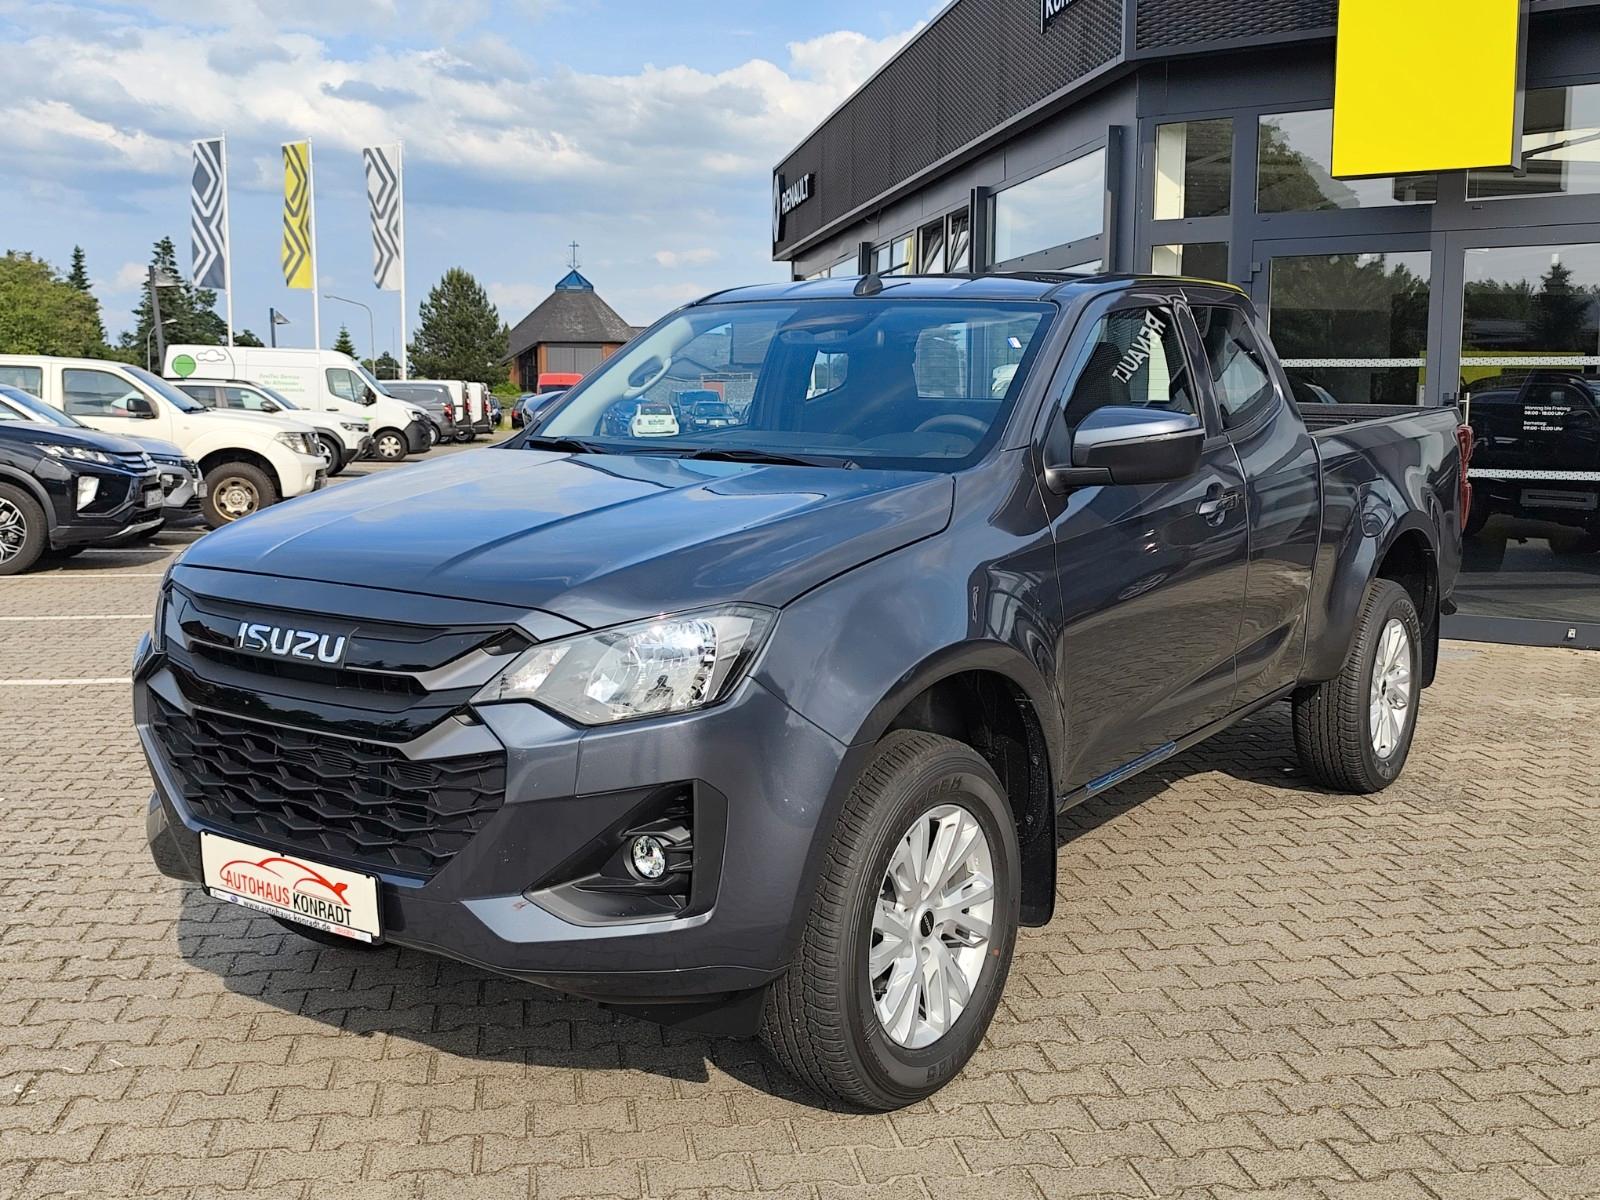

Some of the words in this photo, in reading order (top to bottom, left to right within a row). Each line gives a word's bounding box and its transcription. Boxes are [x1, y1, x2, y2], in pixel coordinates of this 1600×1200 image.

[781, 173, 809, 215] RENAULT
[238, 622, 346, 664] ISUZU
[226, 870, 290, 905] AUTOHAUS
[293, 892, 352, 926] KONRADT
[243, 900, 332, 932] www.autohaus-konradt.de
